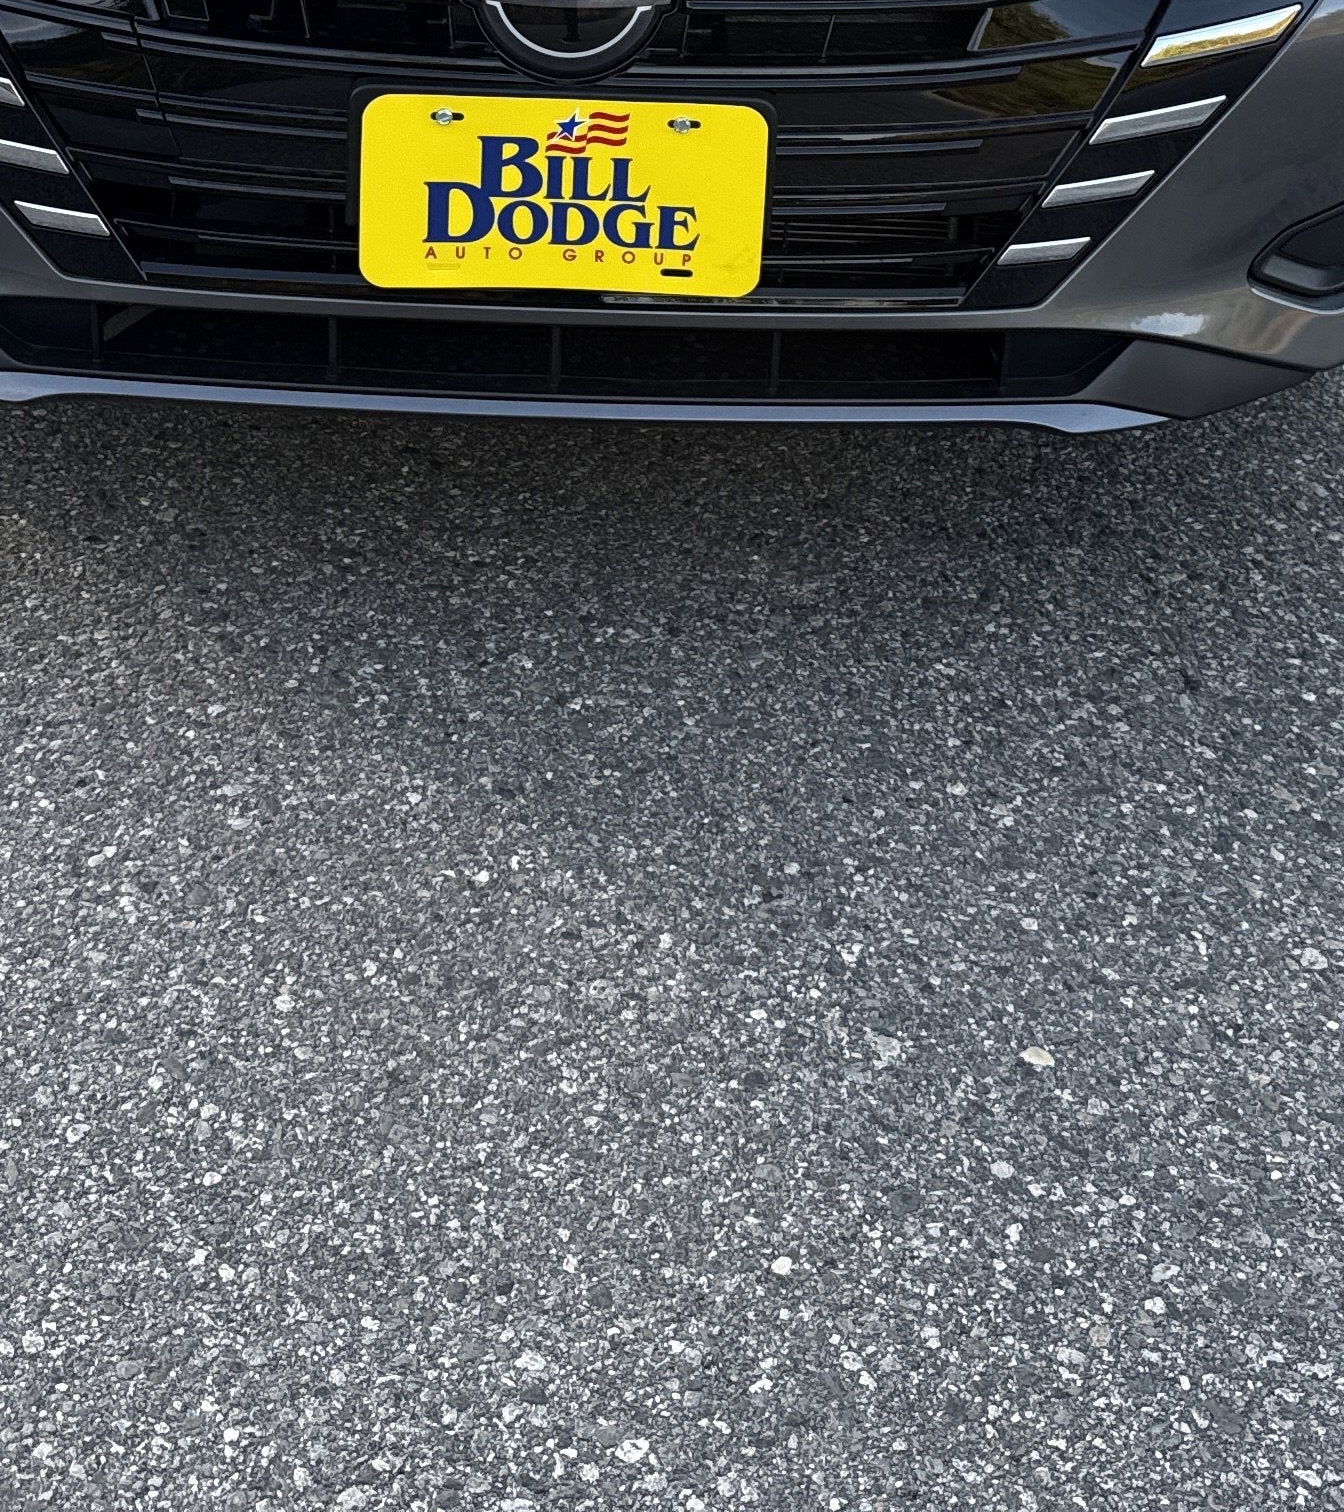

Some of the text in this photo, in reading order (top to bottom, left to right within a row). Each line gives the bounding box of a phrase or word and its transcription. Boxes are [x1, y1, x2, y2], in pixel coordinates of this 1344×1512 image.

[477, 135, 651, 202] BILL
[423, 181, 700, 251] DODGE
[424, 246, 693, 267] AUTO GROUP
